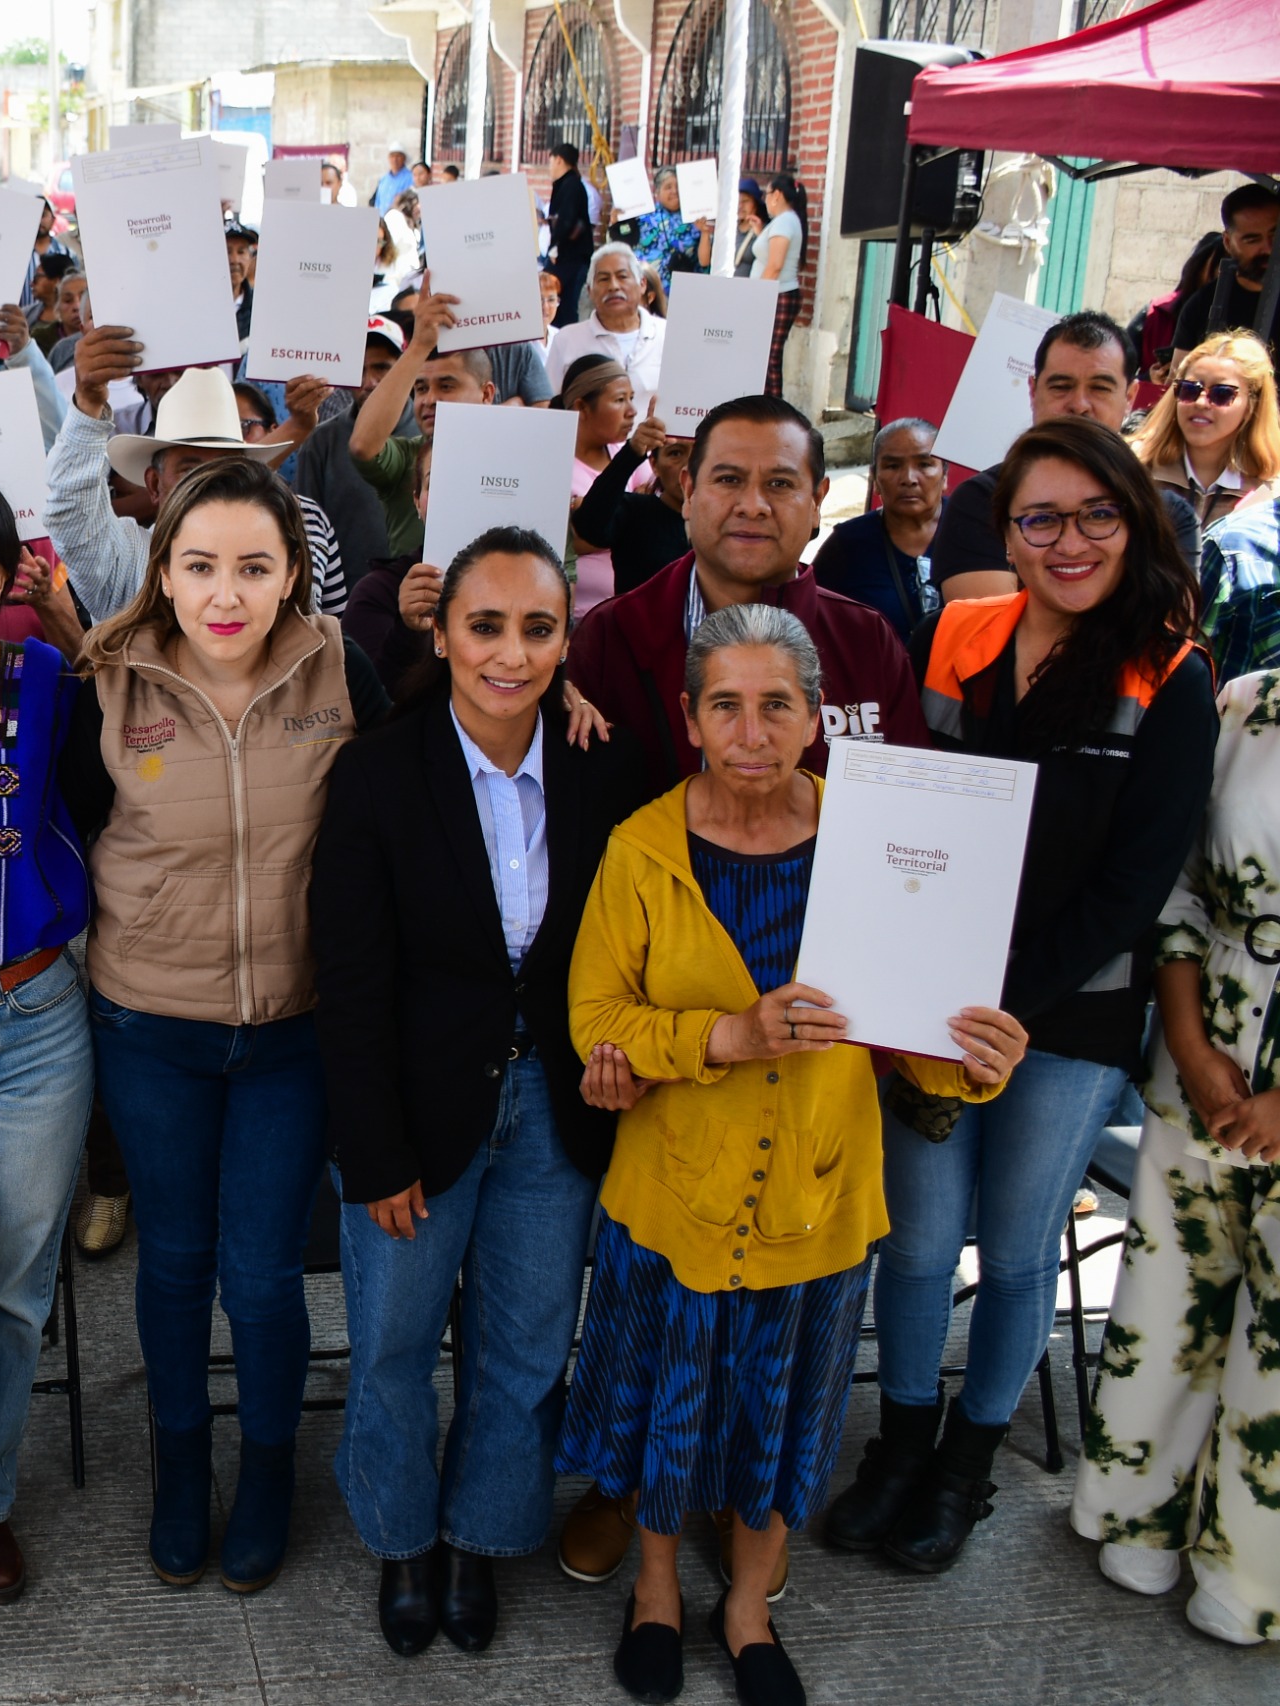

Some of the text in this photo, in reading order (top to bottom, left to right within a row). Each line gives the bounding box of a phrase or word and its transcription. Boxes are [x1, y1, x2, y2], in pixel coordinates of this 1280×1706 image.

[126, 213, 172, 227] Desarrollo
[128, 222, 172, 236] Territorial
[464, 231, 495, 244] INSUS
[299, 261, 332, 273] INSUS
[456, 311, 522, 328] ESCRITURA
[703, 328, 734, 339] INSUS
[270, 348, 341, 362] ESCRITURA
[480, 475, 520, 489] INSUS
[123, 717, 176, 734] Desarrollo
[282, 707, 341, 731] INSUS
[124, 727, 176, 745] Territorial
[886, 842, 949, 860] Desarrollo
[886, 854, 947, 872] Territorial
